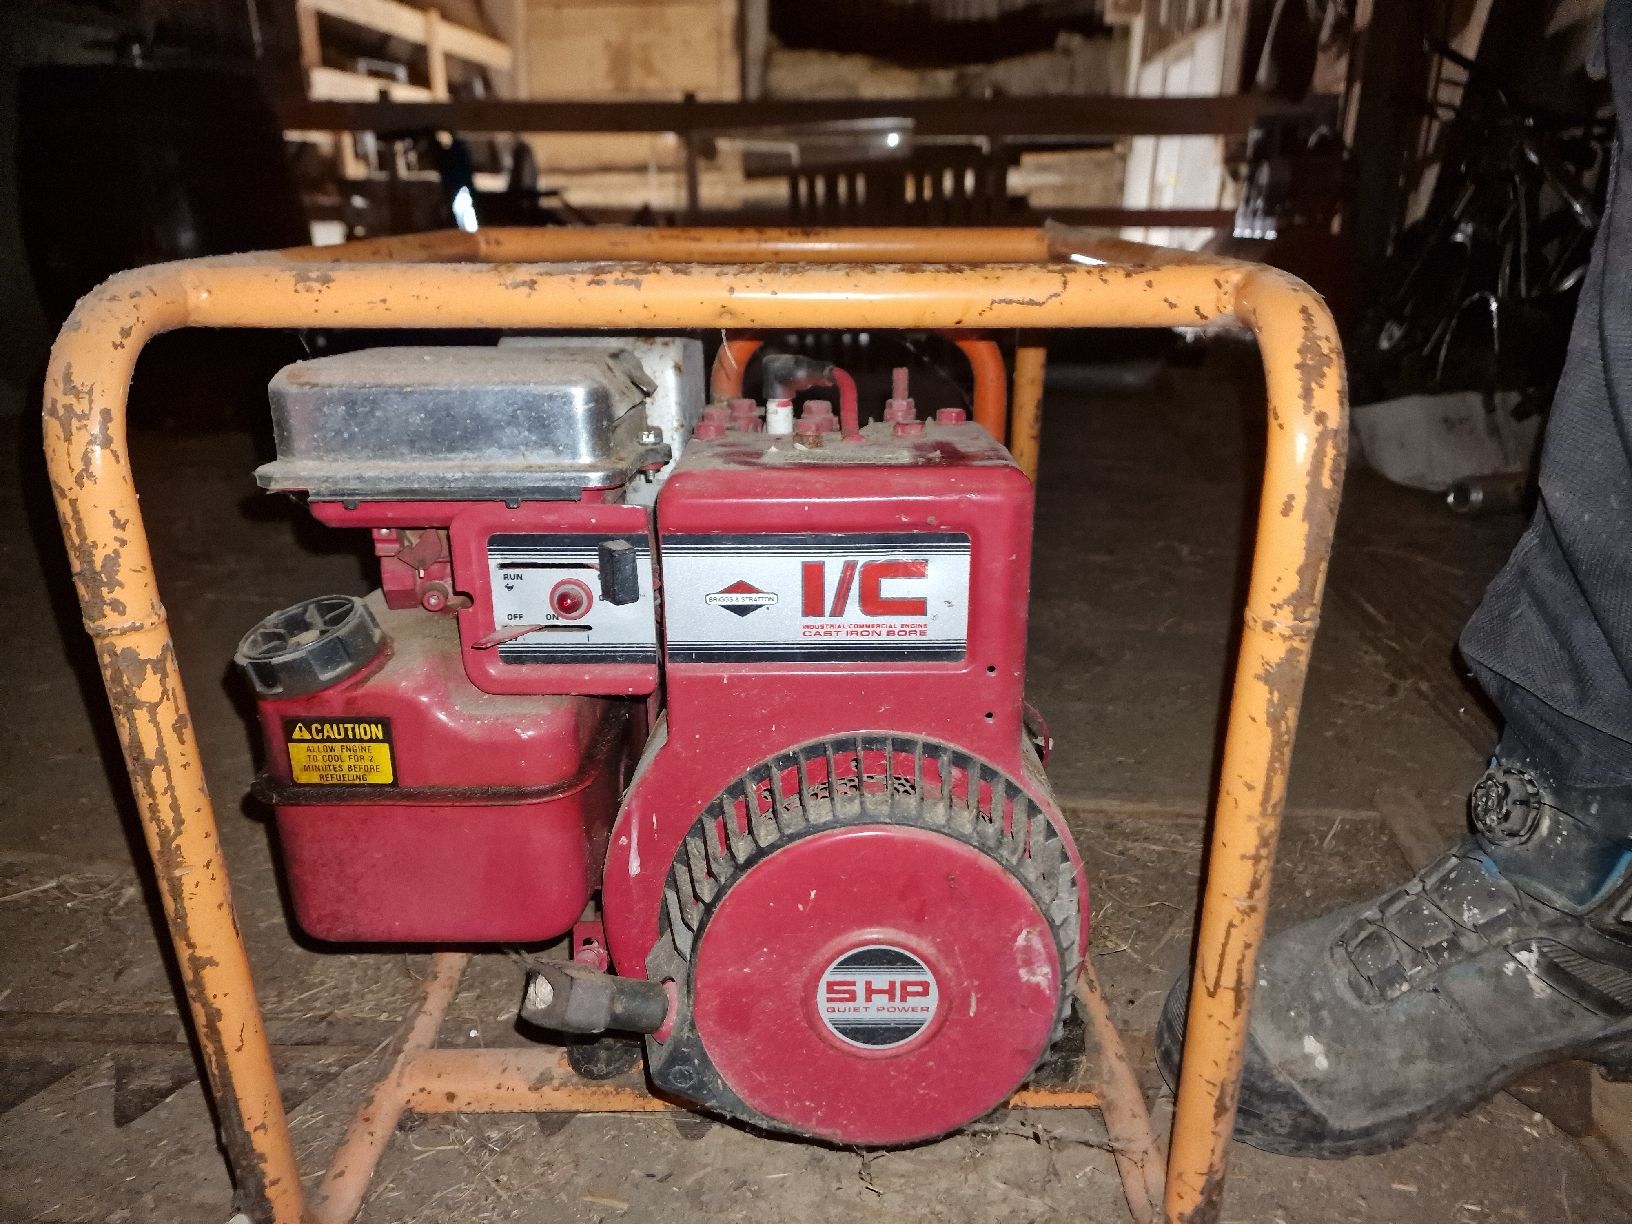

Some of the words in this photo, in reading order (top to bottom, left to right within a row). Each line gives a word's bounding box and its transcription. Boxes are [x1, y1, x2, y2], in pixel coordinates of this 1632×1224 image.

[503, 573, 523, 581] RUN
[801, 559, 929, 617] I/C
[507, 613, 524, 621] OFF
[546, 613, 559, 621] ON
[846, 629, 882, 637] IRON
[886, 629, 928, 637] BORE
[311, 723, 384, 740] CAUTION
[306, 744, 336, 753] ALLOW
[340, 744, 372, 753] ENGINE
[307, 754, 318, 763] TO
[321, 754, 345, 763] COOL
[348, 754, 365, 763] FOR
[369, 755, 374, 763] 2
[303, 764, 344, 773] MINUTES
[347, 764, 380, 773] BEFORE
[319, 773, 368, 782] REFUELING
